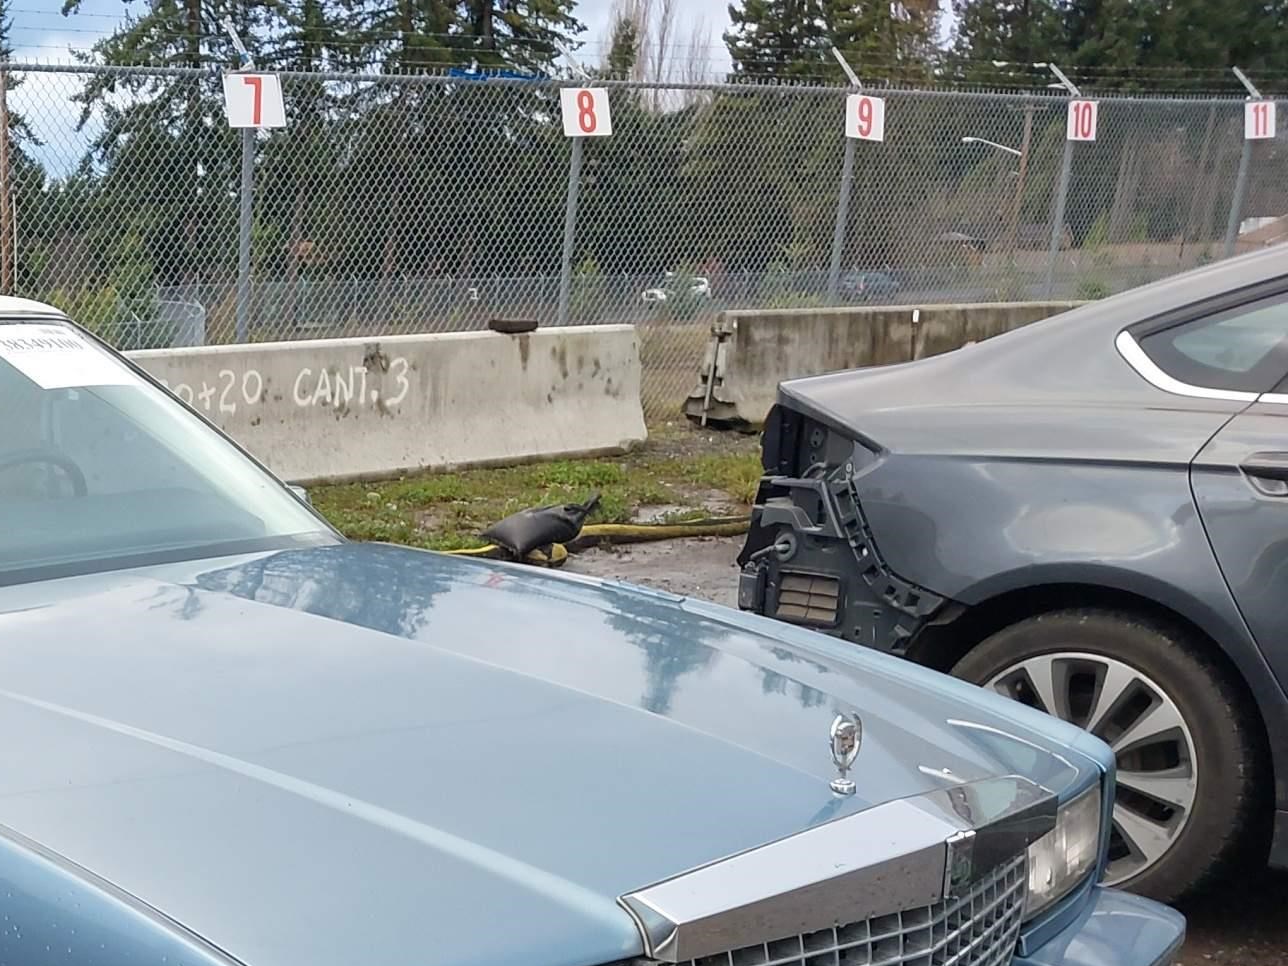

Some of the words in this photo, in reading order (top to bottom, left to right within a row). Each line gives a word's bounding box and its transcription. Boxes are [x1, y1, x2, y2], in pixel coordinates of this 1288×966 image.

[244, 76, 261, 125] 7
[576, 90, 597, 134] 8
[858, 97, 873, 137] 9
[1074, 102, 1092, 138] 10
[1253, 104, 1268, 137] 11
[385, 357, 409, 407] 3
